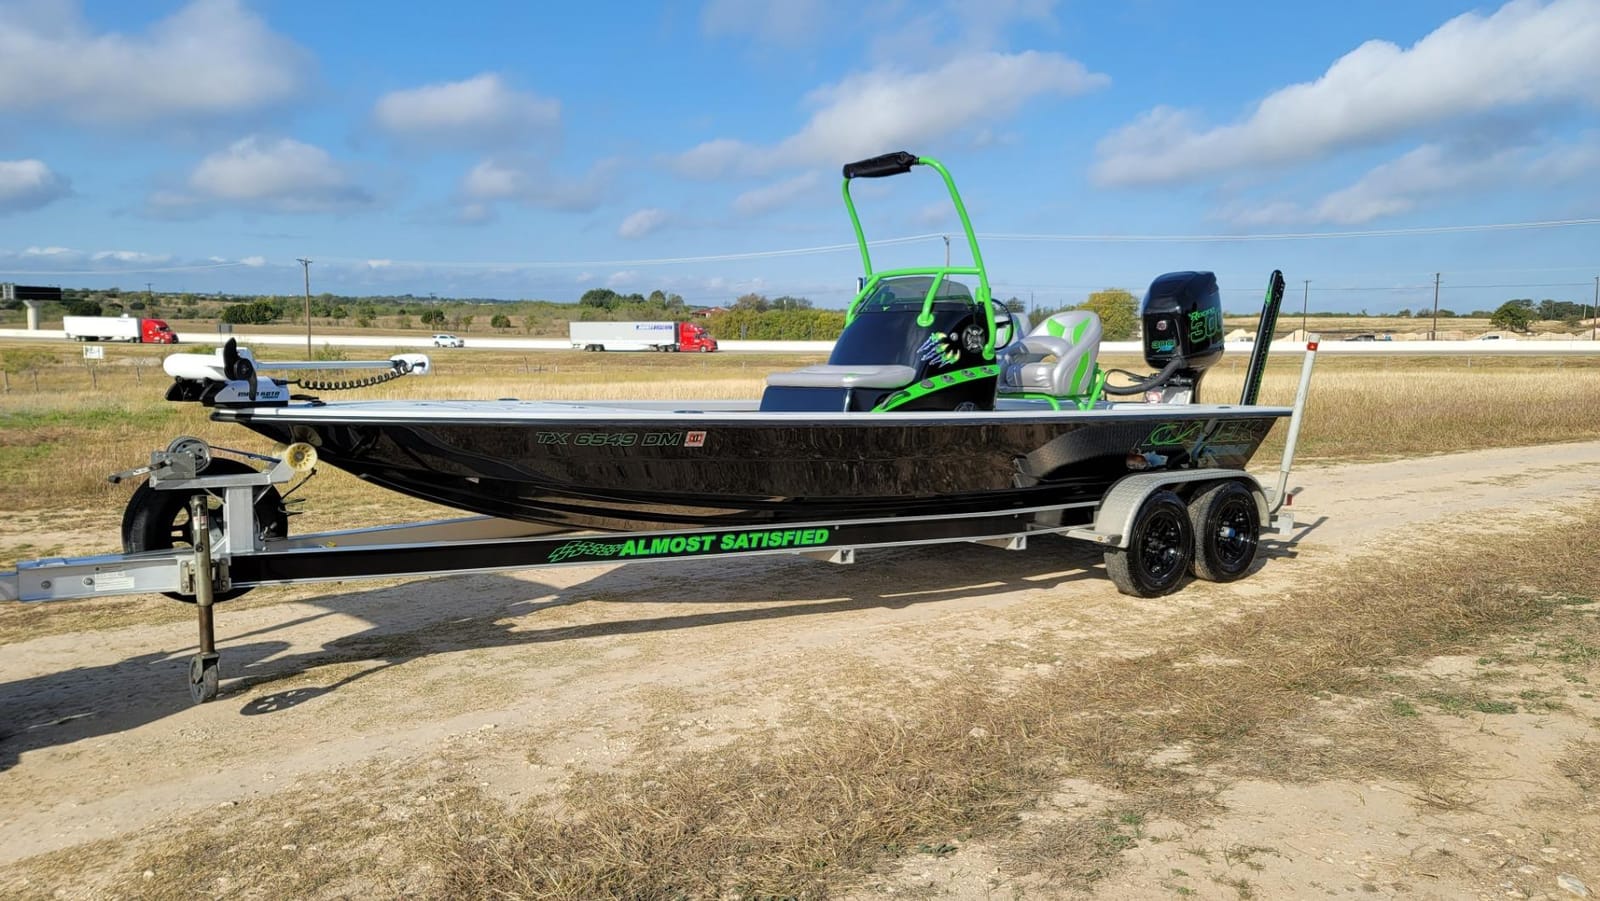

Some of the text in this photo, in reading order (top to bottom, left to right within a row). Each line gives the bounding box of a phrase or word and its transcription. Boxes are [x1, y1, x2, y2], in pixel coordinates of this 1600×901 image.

[536, 431, 570, 444] TX
[573, 432, 639, 447] 6549
[641, 432, 682, 447] DM
[619, 528, 829, 557] ALMOST SATISFIED
